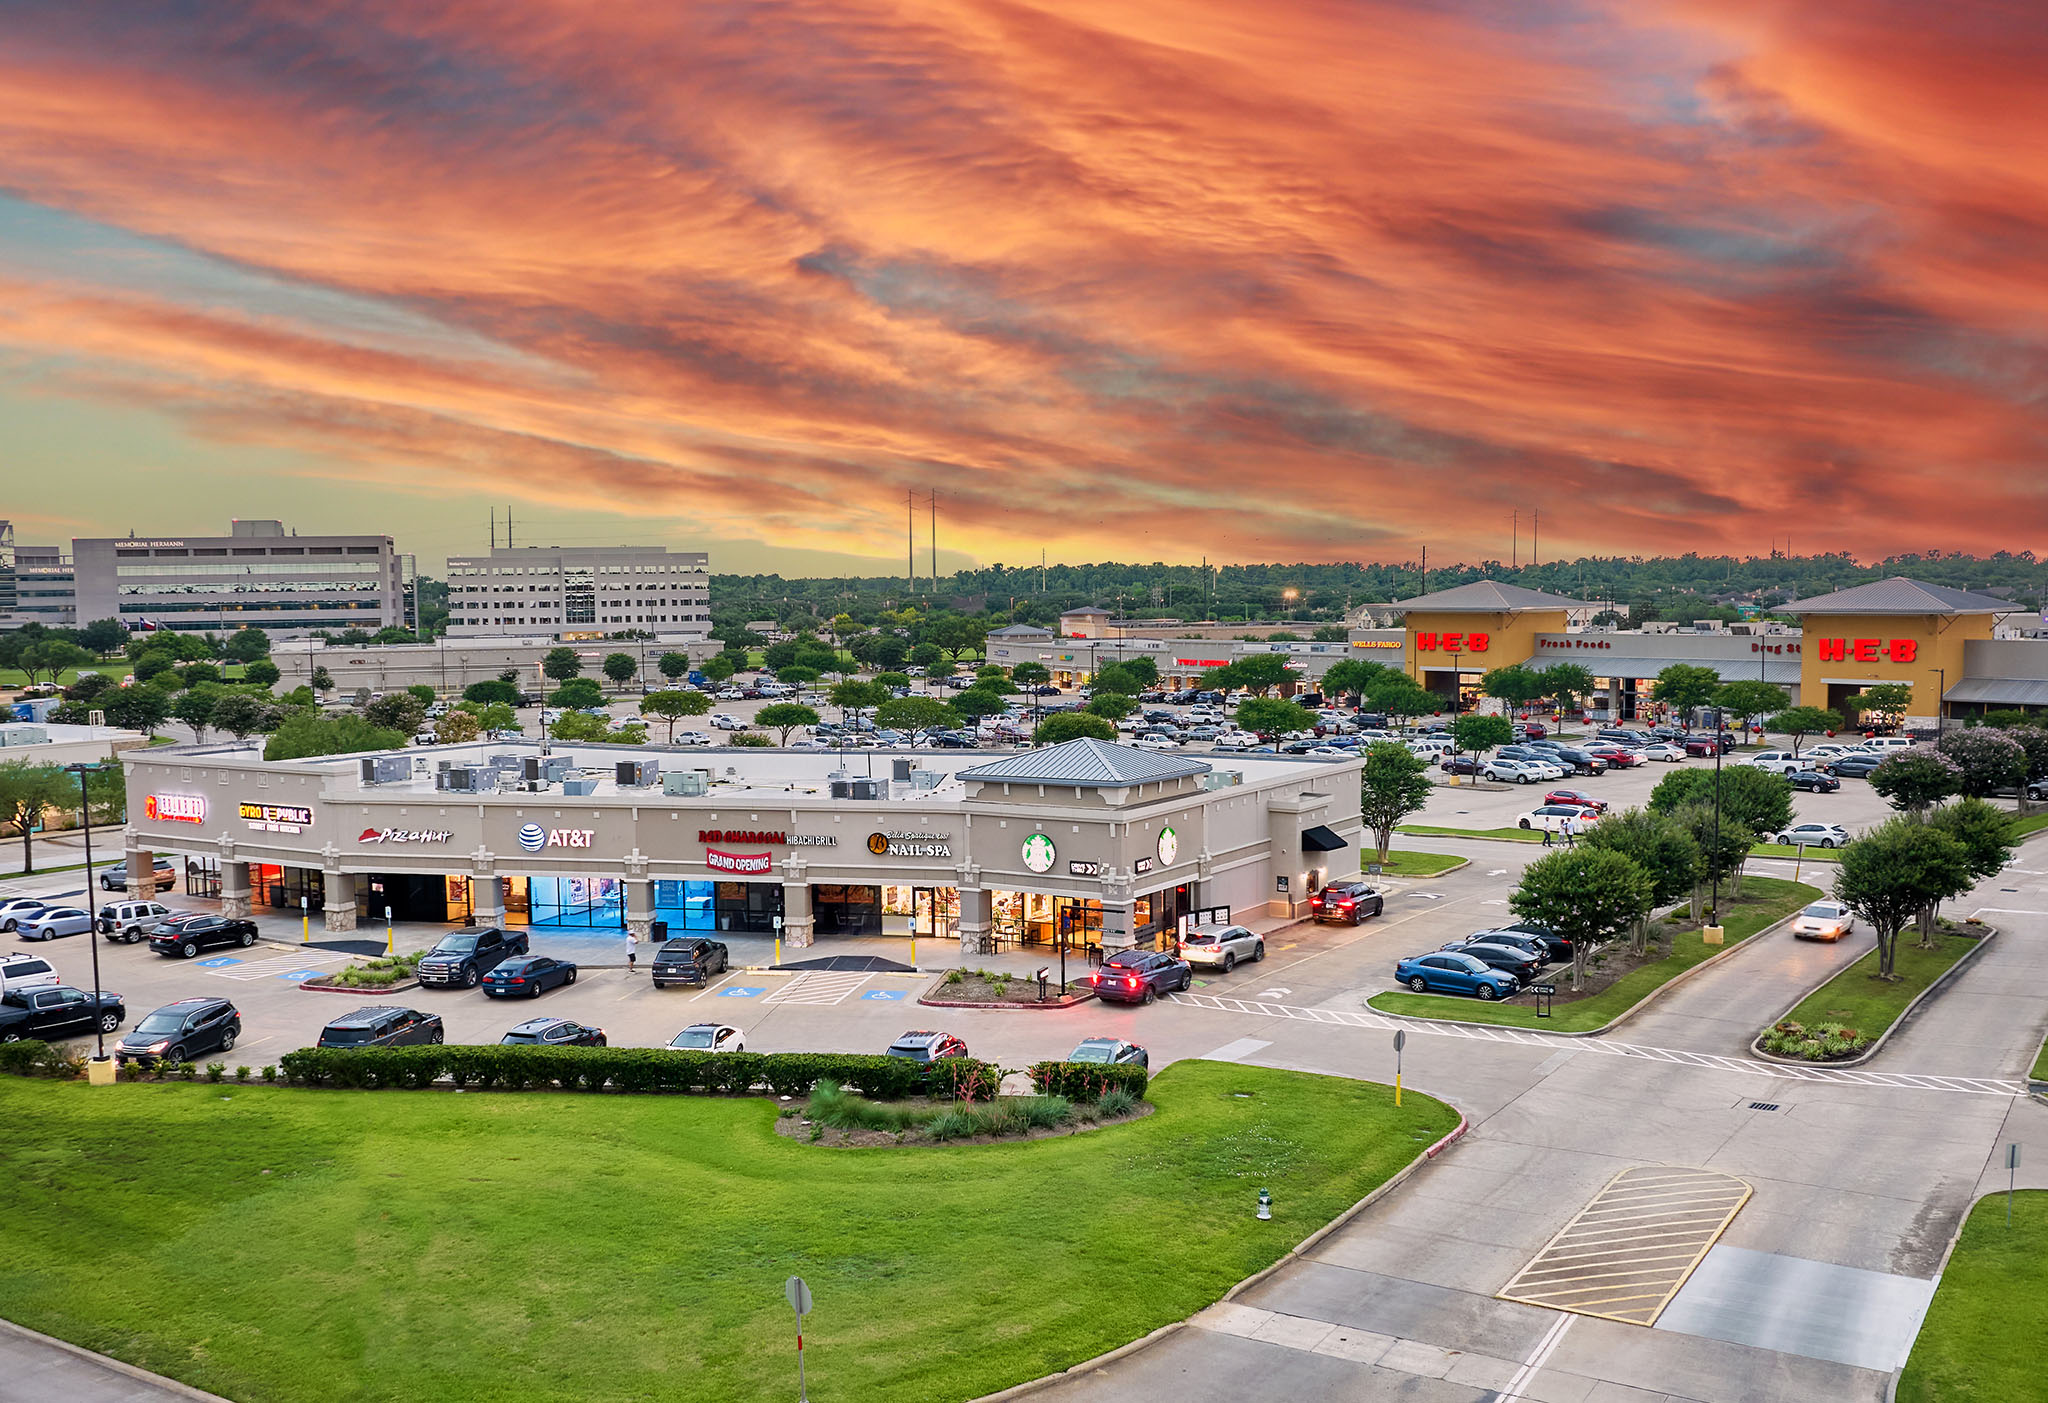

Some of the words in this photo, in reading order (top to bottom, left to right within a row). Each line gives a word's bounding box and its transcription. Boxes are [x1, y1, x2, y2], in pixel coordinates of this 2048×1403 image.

[1352, 640, 1376, 648] WELLS
[1377, 641, 1402, 649] FARGO
[1540, 639, 1572, 649] Fresh
[1576, 639, 1611, 649] Foods
[1751, 642, 1782, 655] Drug
[239, 805, 262, 819] GYRO
[262, 806, 309, 824] REPUBLIC
[378, 828, 420, 844] Pizza
[420, 829, 454, 844] Hut
[547, 829, 595, 848] AT&T
[698, 830, 722, 843] RED
[723, 830, 786, 845] CHARCOAL
[786, 835, 814, 846] HIBACHI
[815, 836, 837, 846] GRILL
[888, 844, 922, 856] NAIL
[926, 844, 952, 857] SPA
[708, 853, 734, 869] GRAND
[735, 856, 769, 872] OPENING
